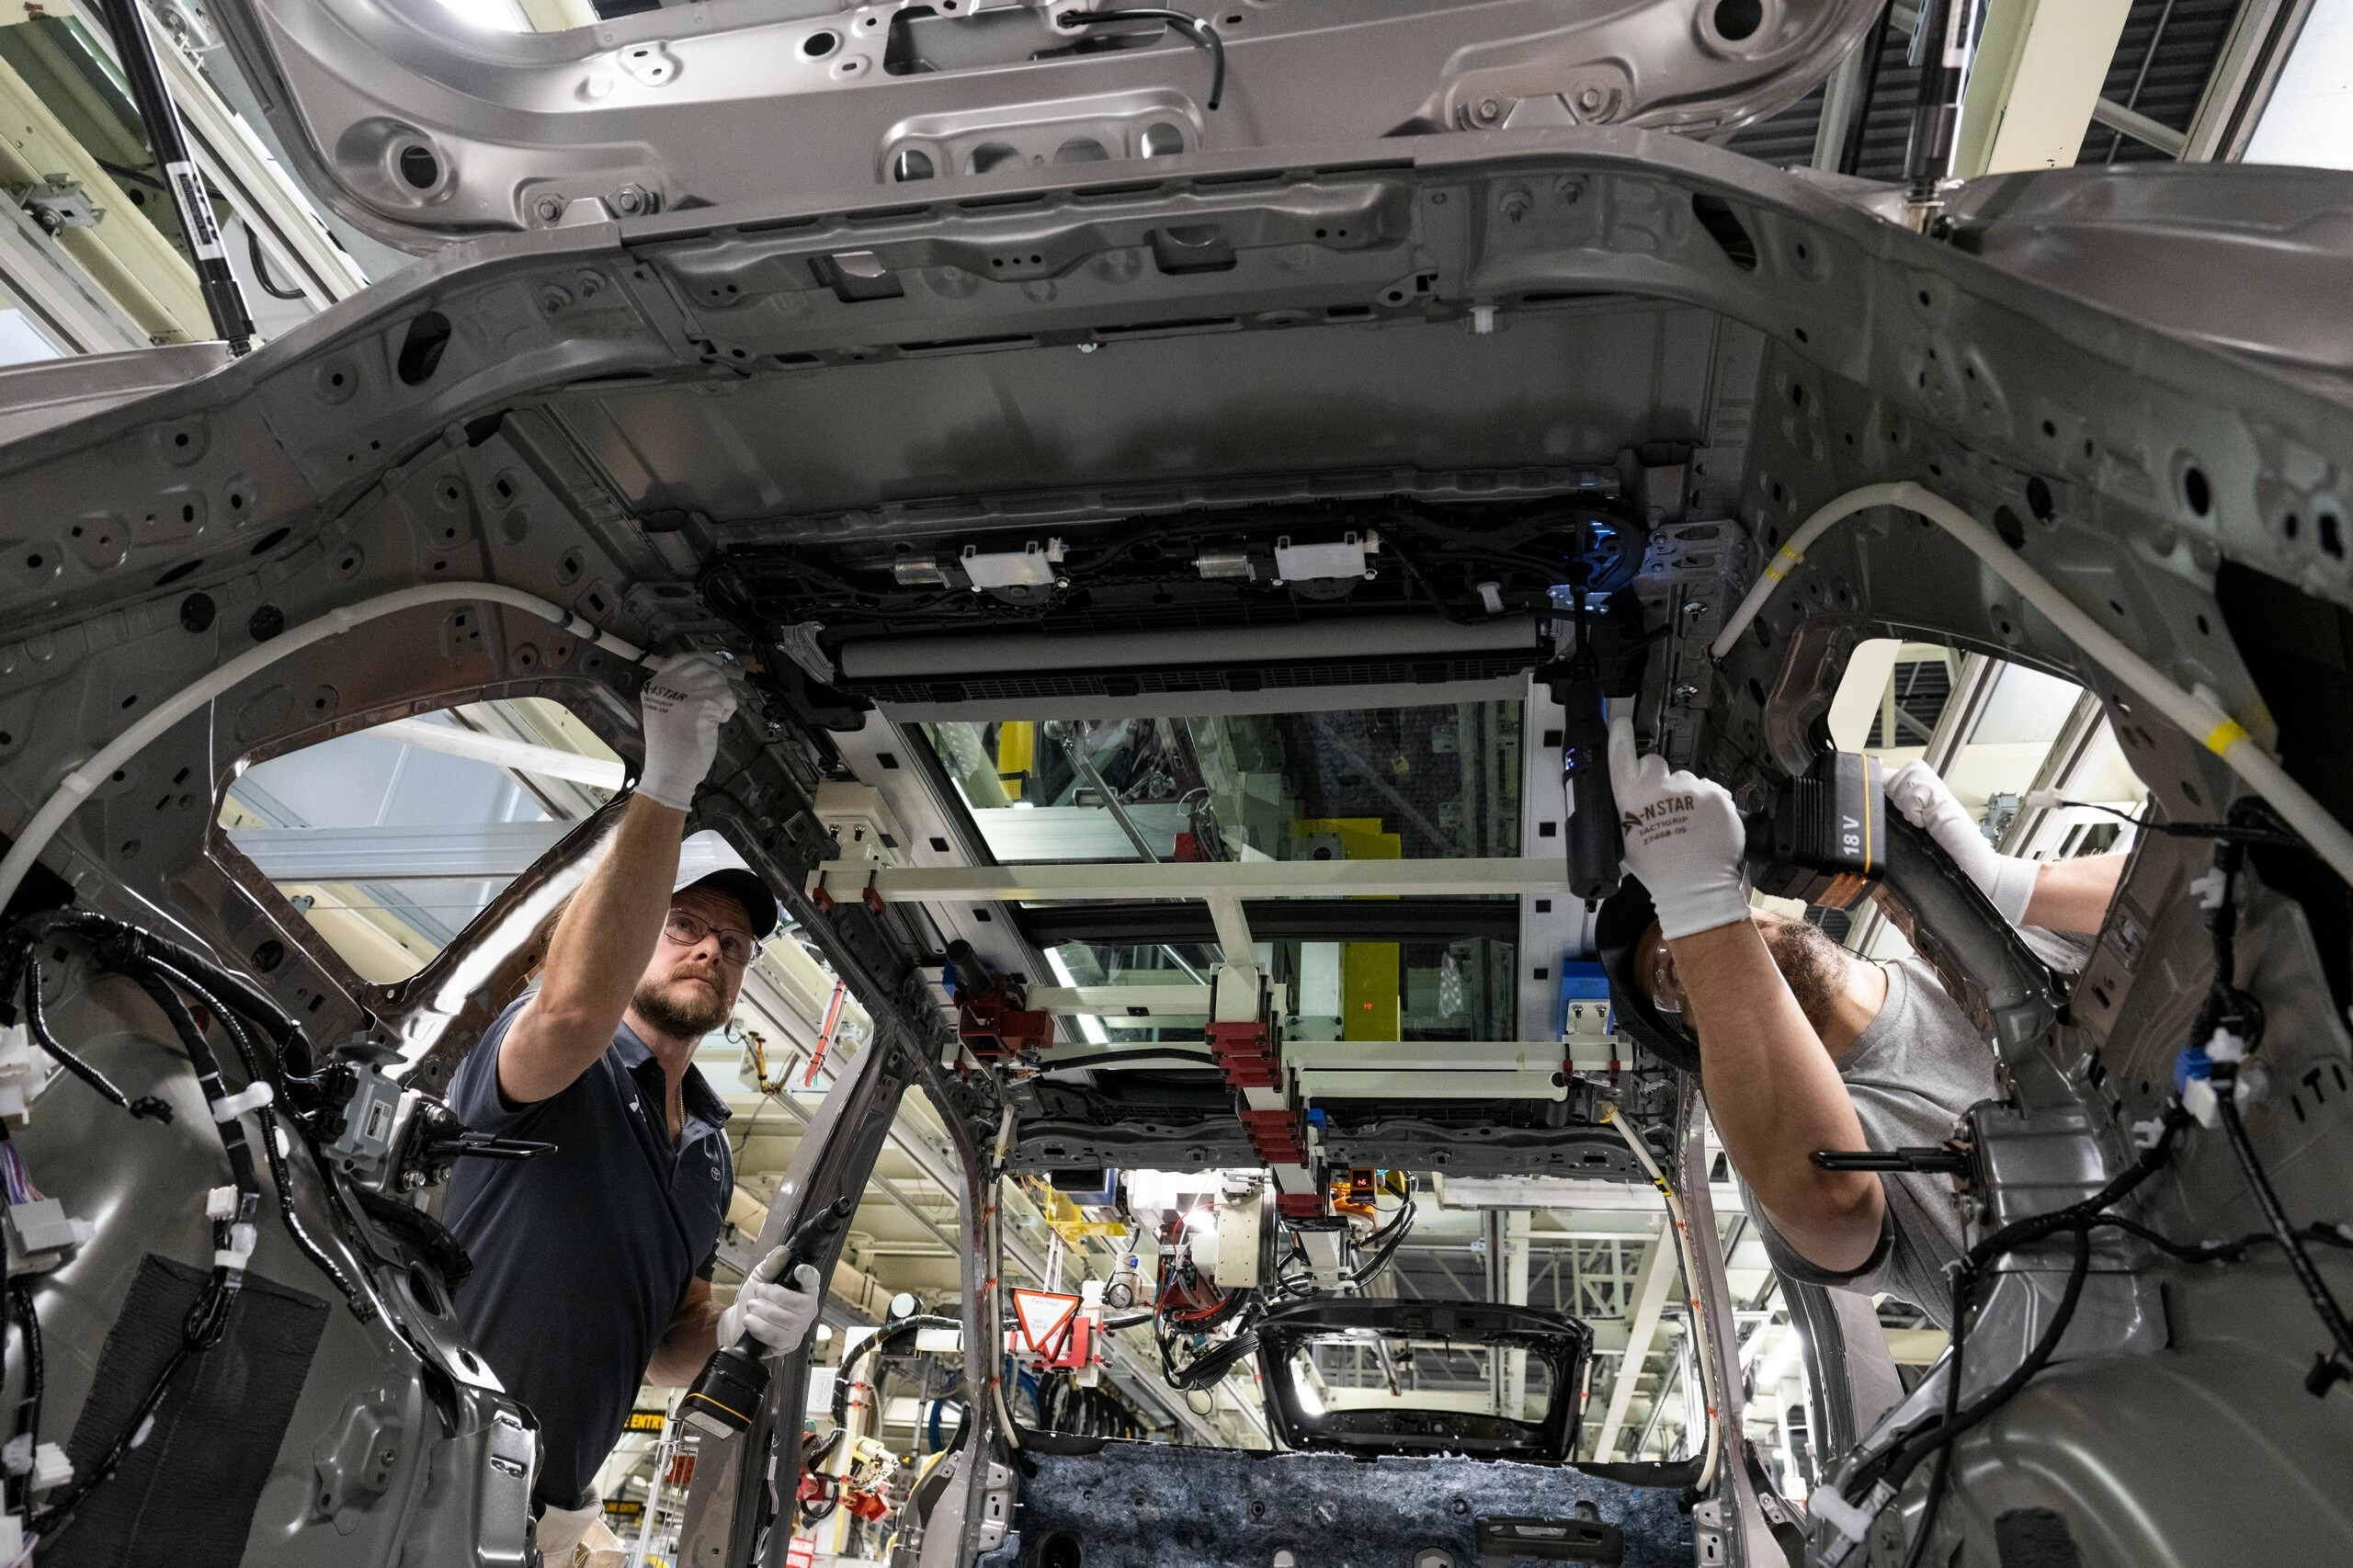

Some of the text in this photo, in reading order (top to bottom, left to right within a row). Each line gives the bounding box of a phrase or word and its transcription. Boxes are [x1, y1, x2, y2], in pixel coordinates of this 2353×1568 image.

[1639, 816, 1688, 836] TACTIGRIP
[1843, 815, 1860, 856] 18 V
[630, 1414, 665, 1429] ENTRY
